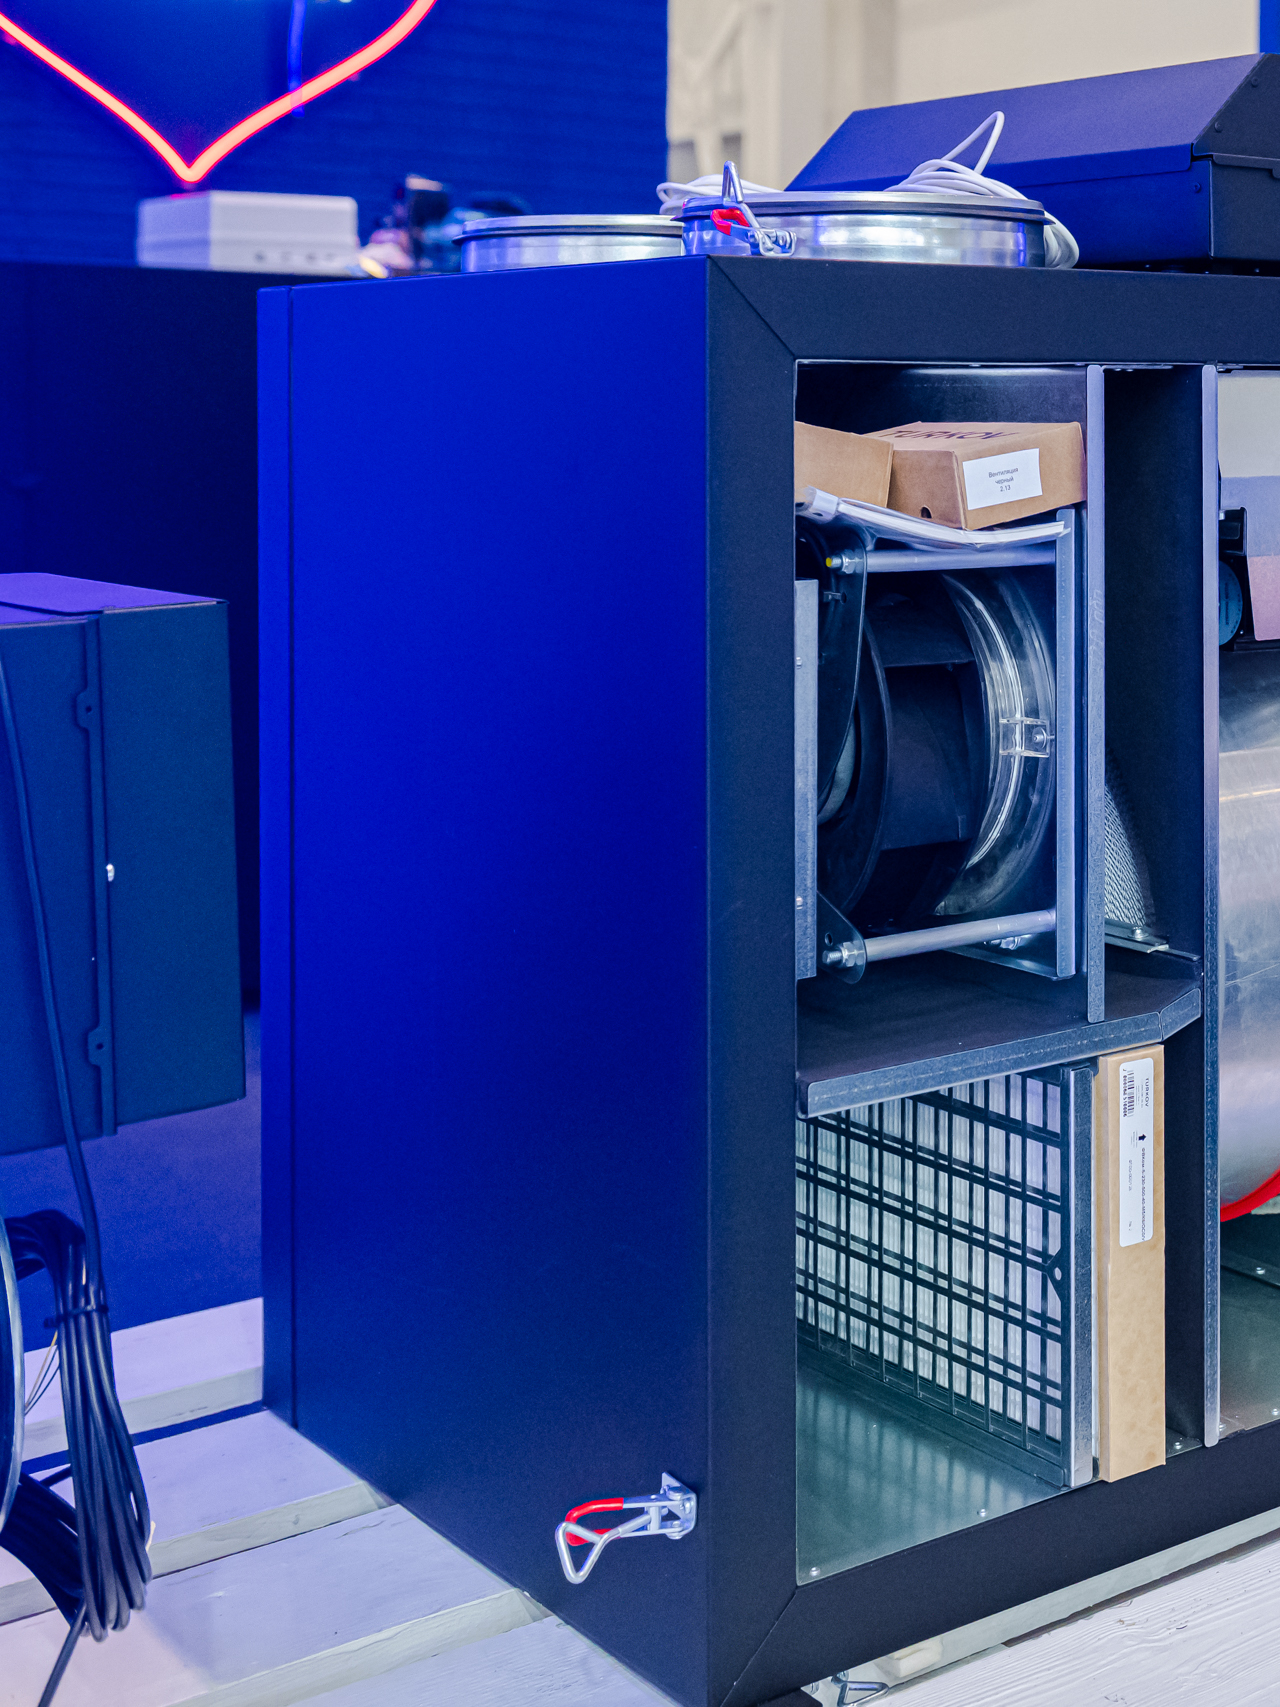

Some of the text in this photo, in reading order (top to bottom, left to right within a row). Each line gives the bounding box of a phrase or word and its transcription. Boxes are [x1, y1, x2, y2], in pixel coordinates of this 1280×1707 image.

[988, 467, 1019, 478] Вентиляция
[995, 476, 1014, 485] черный
[1000, 484, 1011, 492] 2.13
